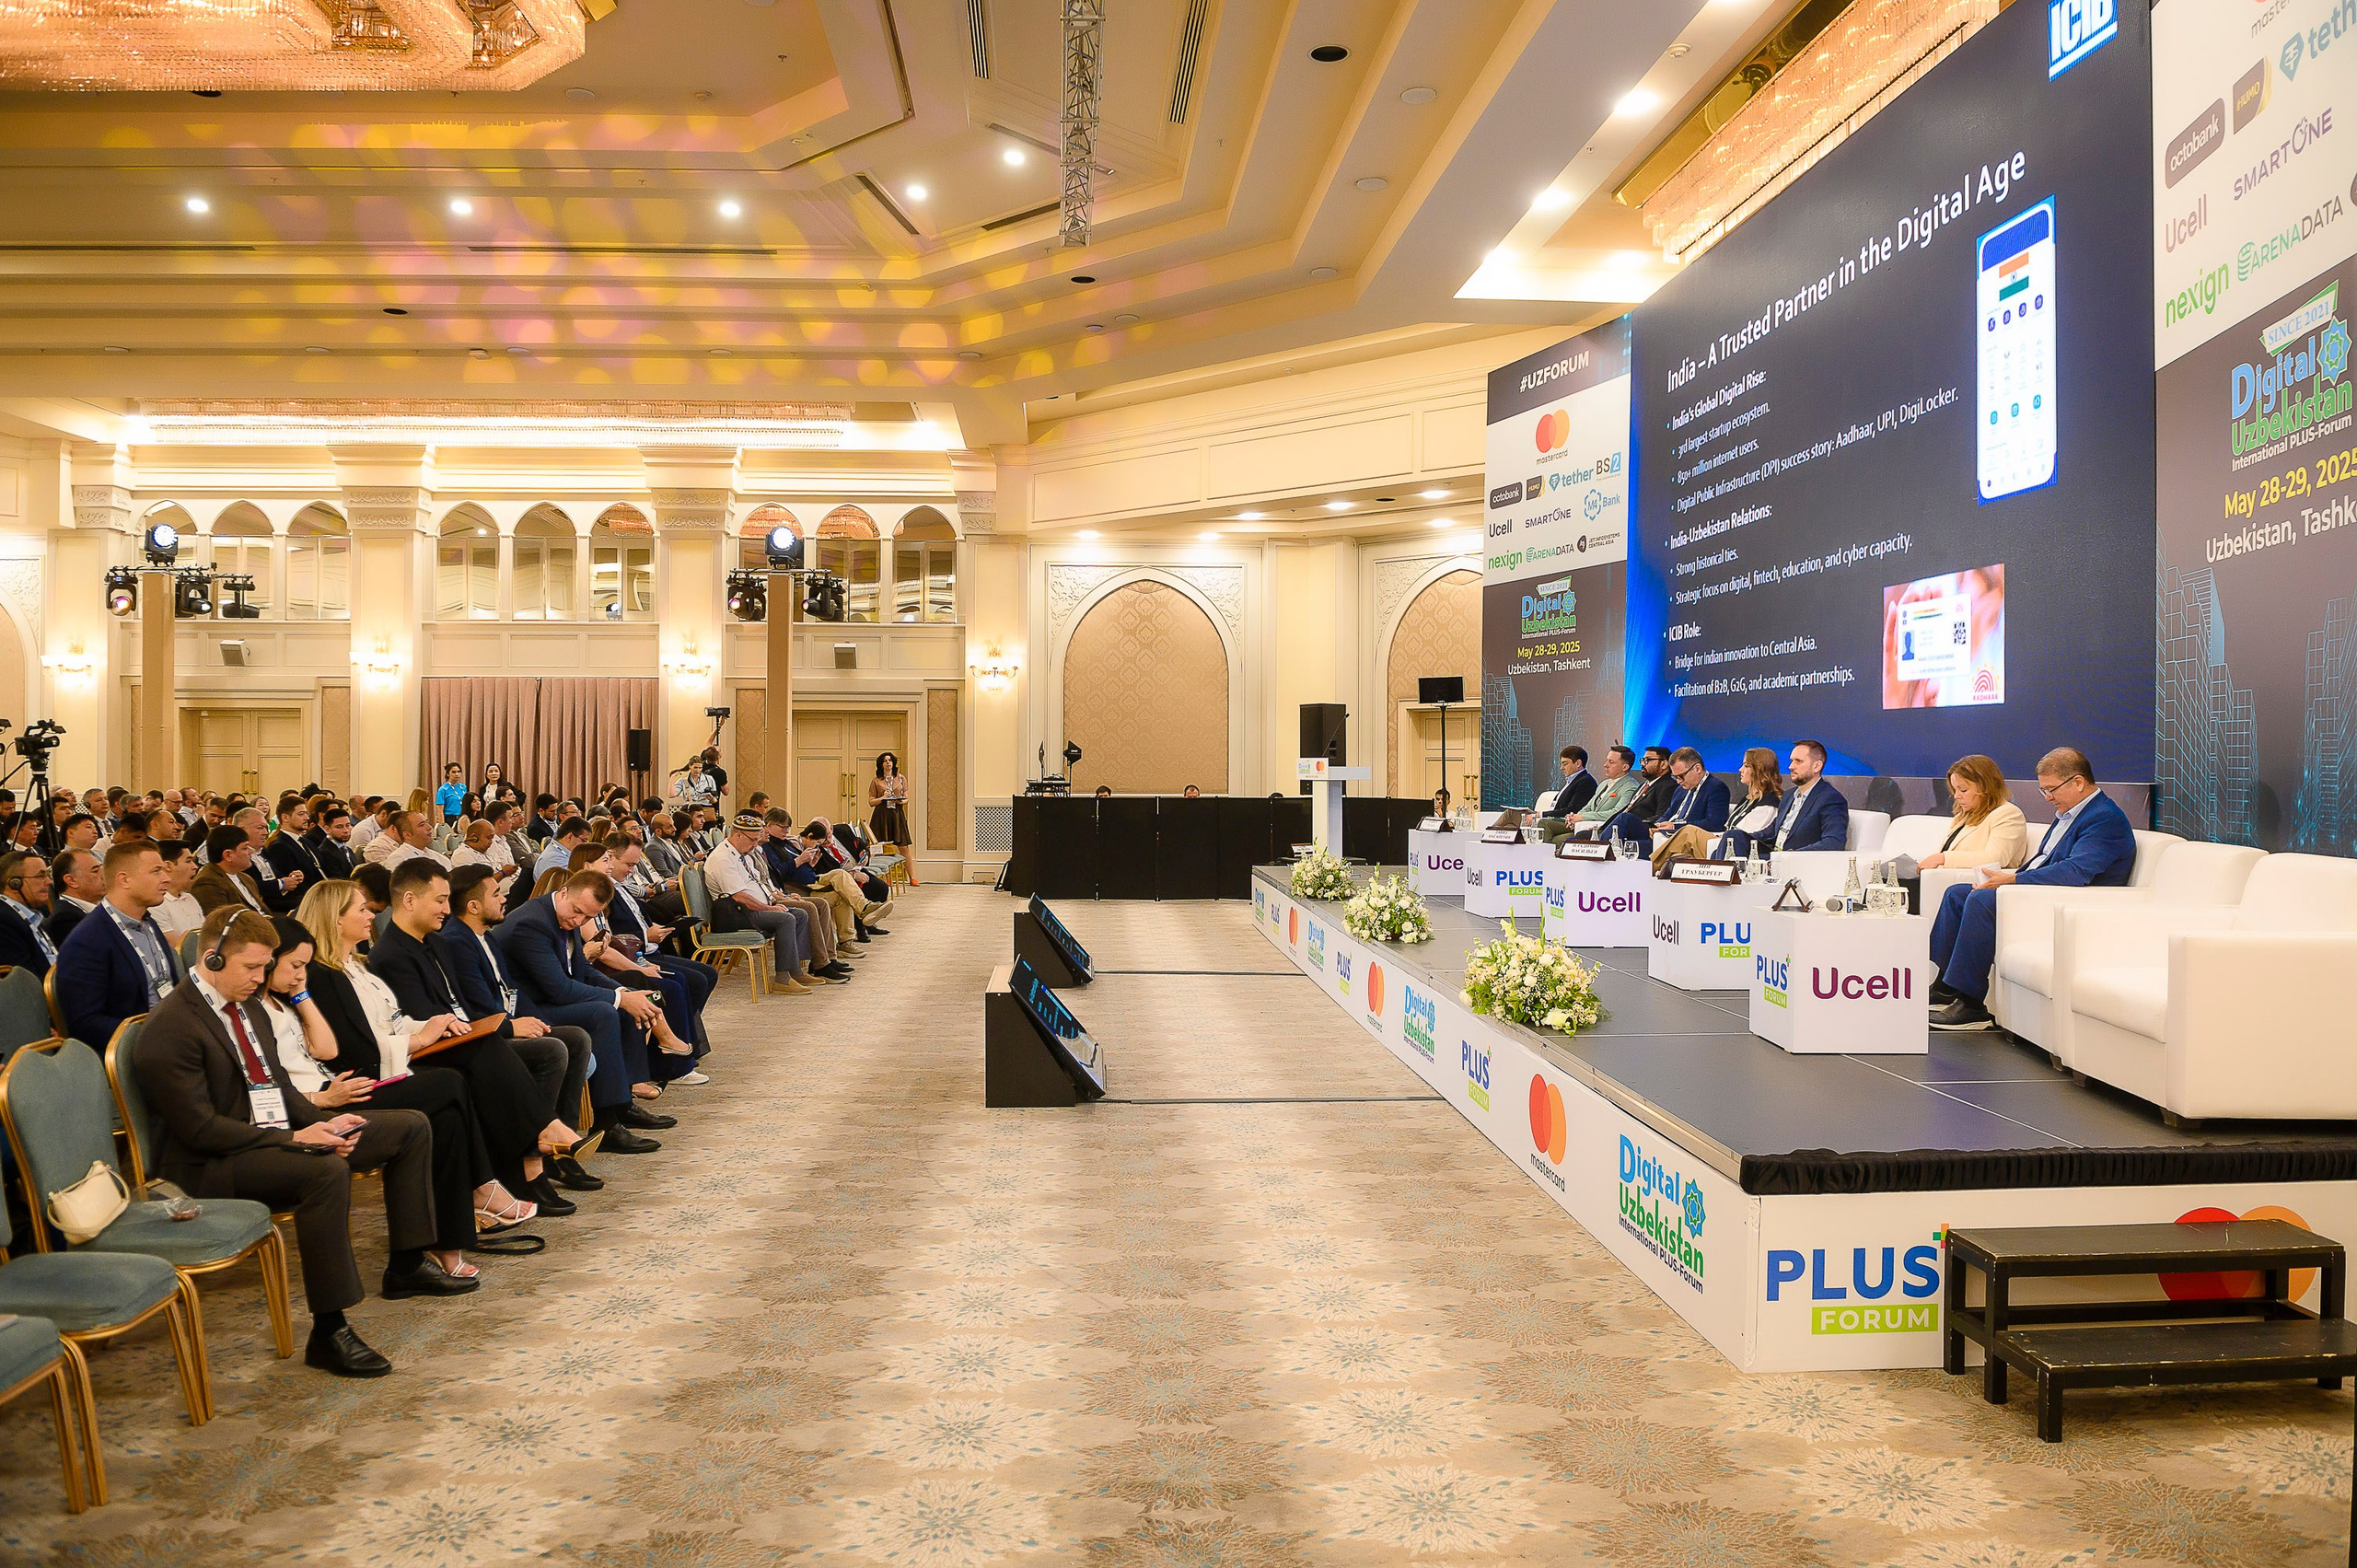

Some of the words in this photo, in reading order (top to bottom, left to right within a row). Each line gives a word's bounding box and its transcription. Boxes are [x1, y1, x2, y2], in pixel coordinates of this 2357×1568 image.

[2236, 81, 2260, 111] HUMO
[2170, 113, 2220, 172] octobank
[2234, 108, 2333, 201] SMARTONE
[2165, 193, 2208, 253] Ucell
[2251, 195, 2343, 274] ARENADATA
[1667, 356, 1696, 393] India
[1707, 343, 1717, 369] A
[1719, 305, 1771, 361] Trusted
[1774, 270, 1835, 328] Partner
[1839, 257, 1856, 289] in
[1860, 236, 1892, 274] the
[1898, 173, 1970, 252] Digital
[1976, 150, 2026, 203] Age
[2165, 262, 2229, 329] nexign
[2268, 316, 2301, 346] SINCE
[2304, 300, 2329, 327] 2021
[1519, 351, 1589, 393] #UZFORUM
[2232, 335, 2316, 419] Digital
[1672, 407, 1694, 431] India's
[1695, 391, 1718, 418] Global
[1719, 376, 1746, 406] Digital
[1747, 370, 1767, 390] Rise:
[2232, 372, 2352, 456] Uzbekistan
[1678, 438, 1688, 459] 3rd
[1689, 431, 1708, 452] largest
[1709, 420, 1731, 441] startup
[1732, 402, 1771, 430] ecosystem.
[2232, 436, 2288, 472] International
[2290, 414, 2352, 449] PLUS-Forum
[1536, 448, 1569, 465] mastercard
[1678, 492, 1696, 514] Digital
[1697, 485, 1715, 505] Public
[1715, 470, 1760, 497] Infrastructure
[1761, 459, 1780, 481] (DPI)
[1781, 448, 1810, 471] success
[1811, 439, 1835, 459] story:
[1836, 422, 1875, 449] Aadhaar,
[1877, 410, 1898, 432] UPI,
[1900, 387, 1959, 424] DigiLocker.
[1678, 470, 1690, 486] 850+
[1692, 459, 1712, 478] million
[1713, 446, 1738, 468] internet
[1739, 438, 1759, 456] users.
[1562, 467, 1594, 488] tether
[2224, 489, 2257, 519] May
[2259, 466, 2312, 507] 28-29,
[1492, 488, 1520, 504] octobank
[1602, 494, 1620, 507] Bank
[1489, 518, 1513, 538] Ucell
[1525, 507, 1572, 528] SMARTONE
[1671, 519, 1730, 550] India-Uzbekistan
[1731, 505, 1772, 529] Relations:
[2206, 519, 2297, 563] Uzbekistan,
[2301, 494, 2357, 537] Tashk
[1488, 550, 1523, 571] nexign
[1532, 543, 1574, 561] ARENADATA
[1676, 562, 1695, 576] Strong
[1696, 549, 1724, 569] historical
[1725, 548, 1739, 561] ties.
[1676, 588, 1701, 605] Strategic
[1702, 583, 1719, 598] focus
[1720, 582, 1728, 593] on
[1729, 572, 1752, 595] digital,
[1753, 565, 1781, 587] fintech,
[1782, 556, 1824, 579] education,
[1825, 548, 1841, 568] and
[1842, 543, 1868, 567] cyber
[1869, 532, 1913, 561] capacity.
[1521, 609, 1577, 633] Uzbekistan
[1522, 593, 1562, 619] Digital
[1521, 631, 1549, 640] International
[1549, 628, 1576, 637] PLUS-Forum
[1669, 625, 1683, 642] ICIB
[1684, 621, 1701, 639] Role:
[1517, 646, 1533, 659] May
[1534, 643, 1559, 657] 28-29,
[1560, 640, 1581, 654] 2025
[1675, 653, 1693, 671] Bridge
[1694, 652, 1702, 666] for
[1703, 649, 1723, 665] Indian
[1724, 645, 1759, 662] innovation
[1760, 643, 1769, 656] to
[1769, 636, 1797, 656] Central
[1797, 635, 1817, 652] Asia.
[1507, 661, 1552, 676] Uzbekistan,
[1553, 657, 1591, 672] Tashkent
[1674, 681, 1707, 697] Facilitation
[1707, 679, 1715, 694] of
[1715, 679, 1729, 696] B2B,
[1730, 677, 1747, 694] G2G,
[1748, 674, 1762, 691] and
[1763, 671, 1799, 689] academic
[1800, 666, 1855, 691] partnerships.
[1467, 866, 1483, 887] Ucell
[1496, 871, 1543, 886] PLUS
[1546, 887, 1564, 908] PLUS
[1578, 891, 1641, 912] Ucell
[1653, 913, 1679, 946] Ucell
[1337, 951, 1351, 981] PLUS
[1723, 947, 1750, 956] FOR
[1757, 955, 1788, 991] PLUS
[1812, 967, 1911, 999] Ucell
[1405, 985, 1427, 1018] Digital
[1765, 988, 1787, 1007] FORUM
[1404, 1014, 1434, 1054] Uzbekistan
[1462, 1040, 1490, 1090] PLUS
[1469, 1081, 1489, 1110] FORUM
[1530, 1153, 1566, 1193] mastercard
[1620, 1133, 1679, 1206] Digital
[1620, 1181, 1703, 1278] Uzbekistan
[1619, 1213, 1658, 1257] International
[1659, 1247, 1703, 1295] PLUS-Forum
[1767, 1246, 1940, 1302] PLUS
[1820, 1308, 1930, 1331] FORUM
